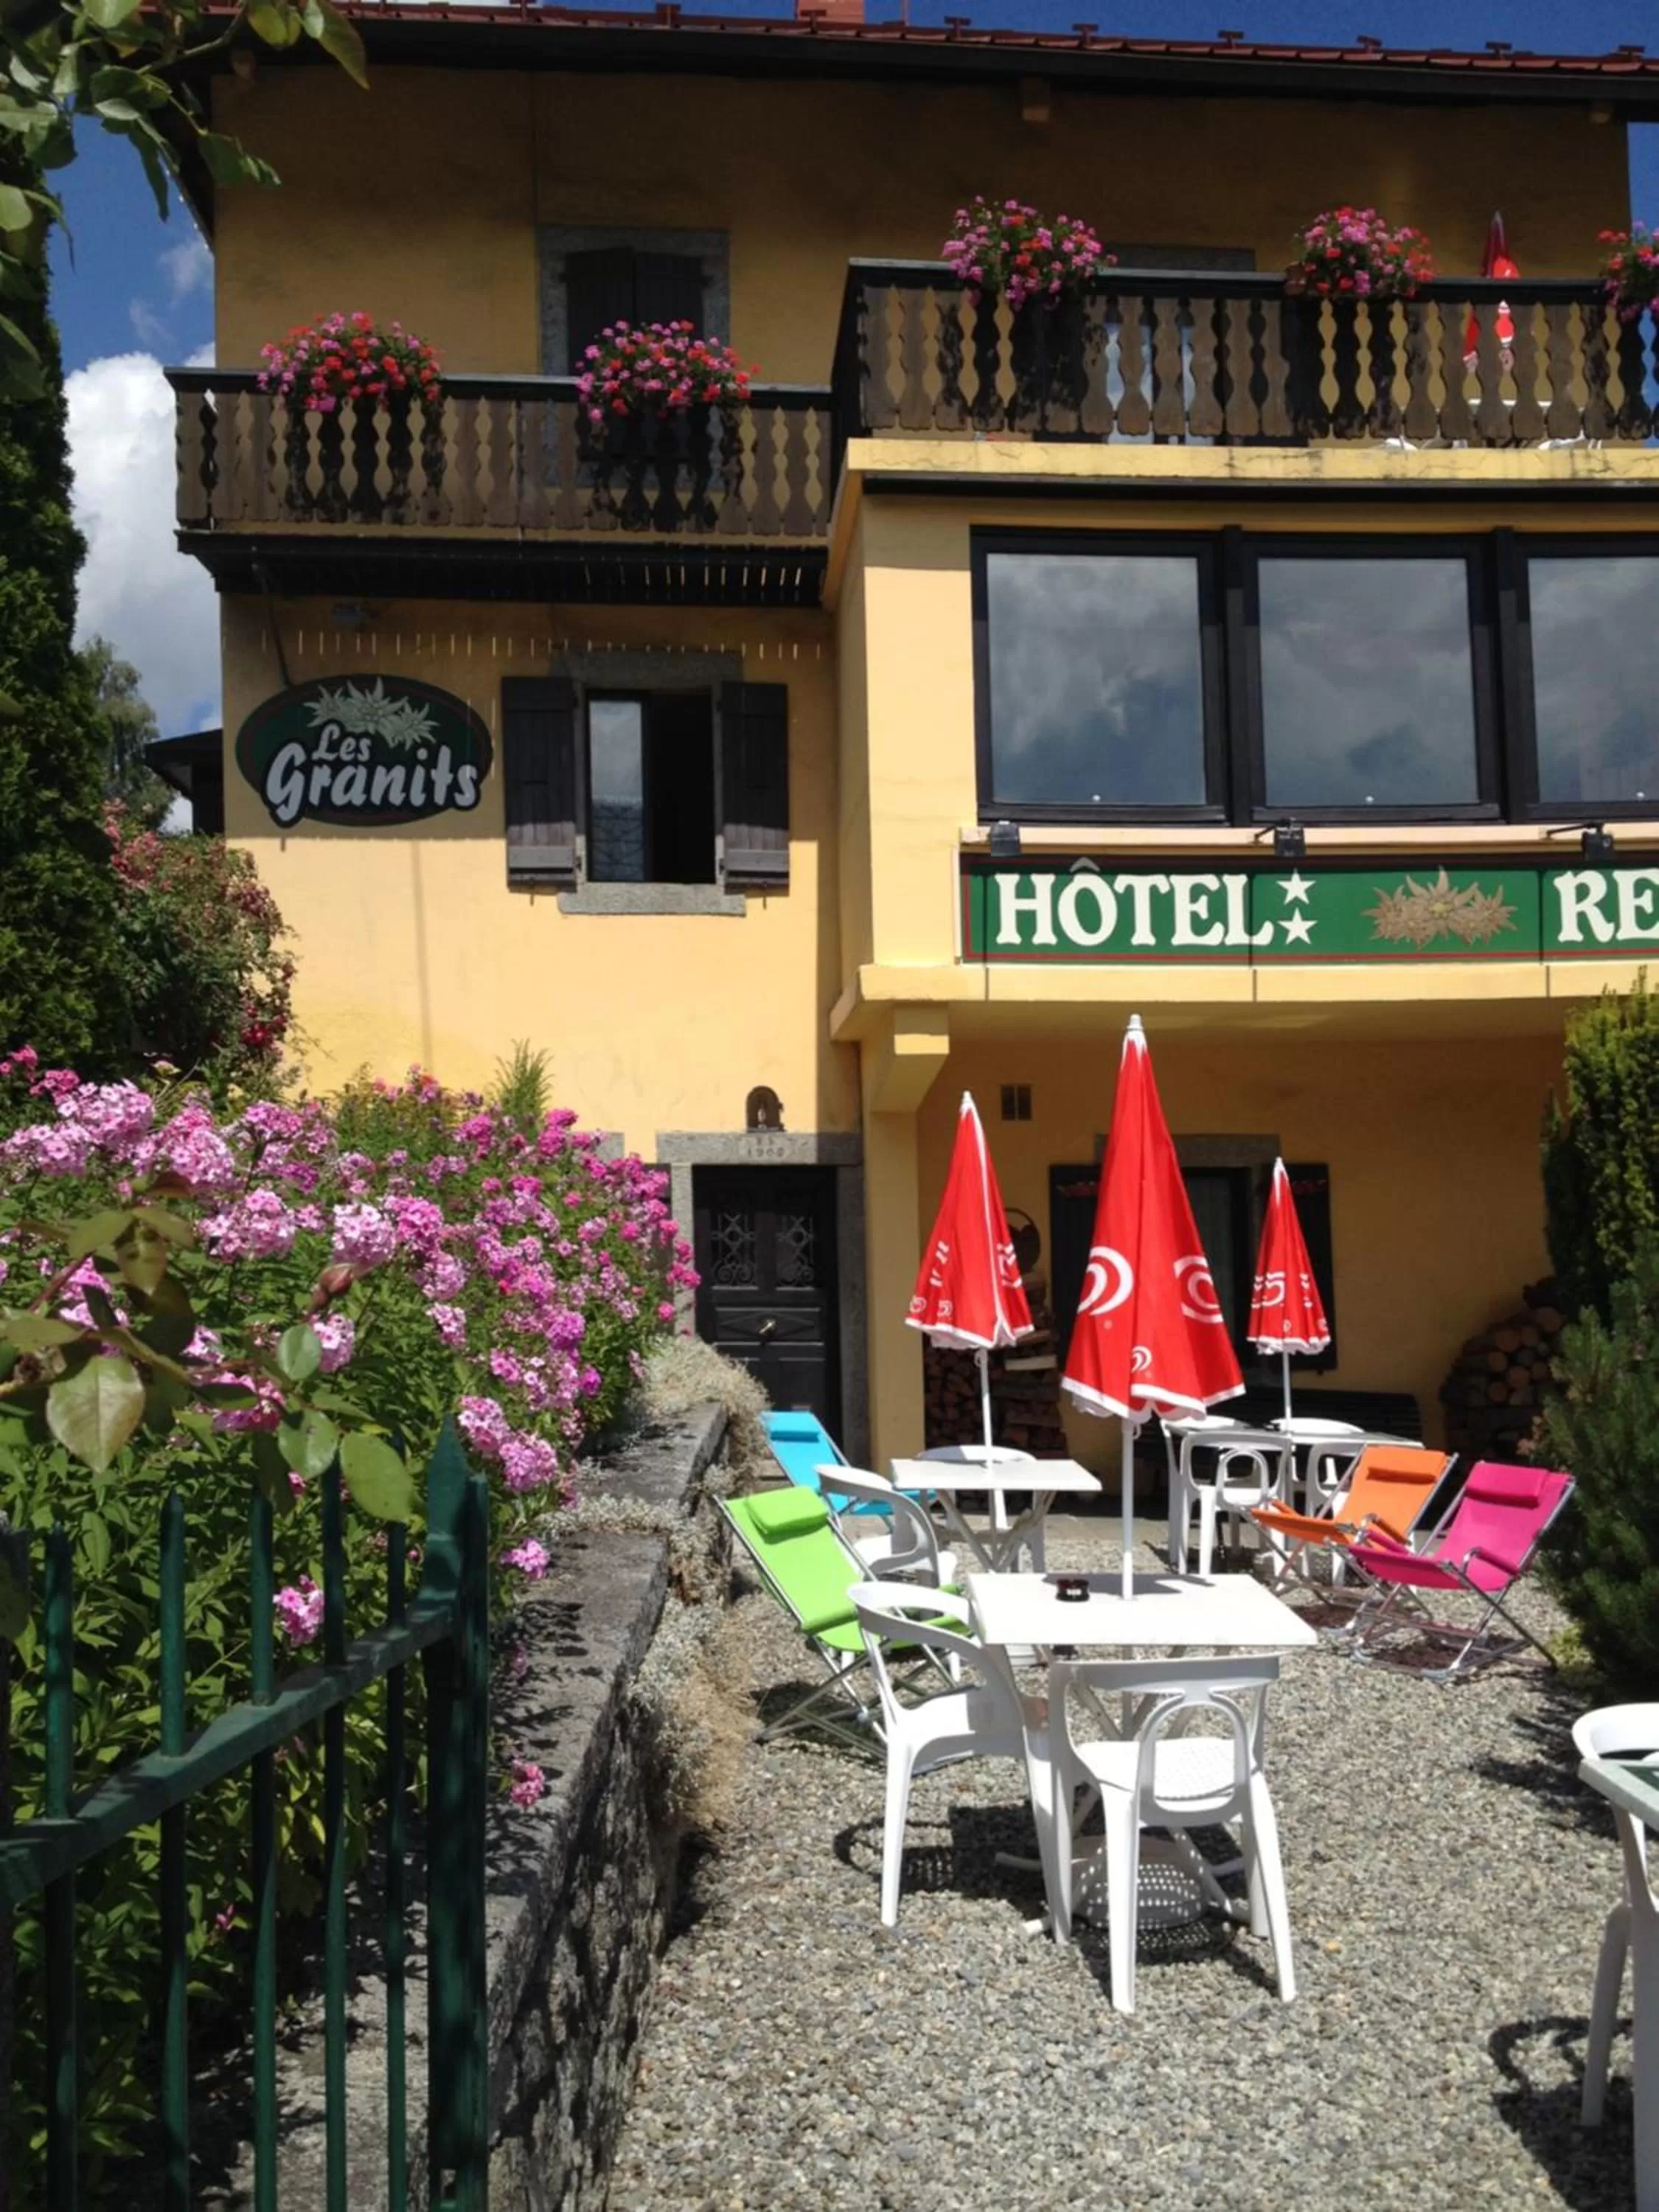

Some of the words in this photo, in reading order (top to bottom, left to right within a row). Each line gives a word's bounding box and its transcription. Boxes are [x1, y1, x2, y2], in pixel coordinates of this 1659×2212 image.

[265, 742, 478, 821] Granits
[310, 723, 371, 761] Les
[994, 856, 1274, 946] HÔTEL
